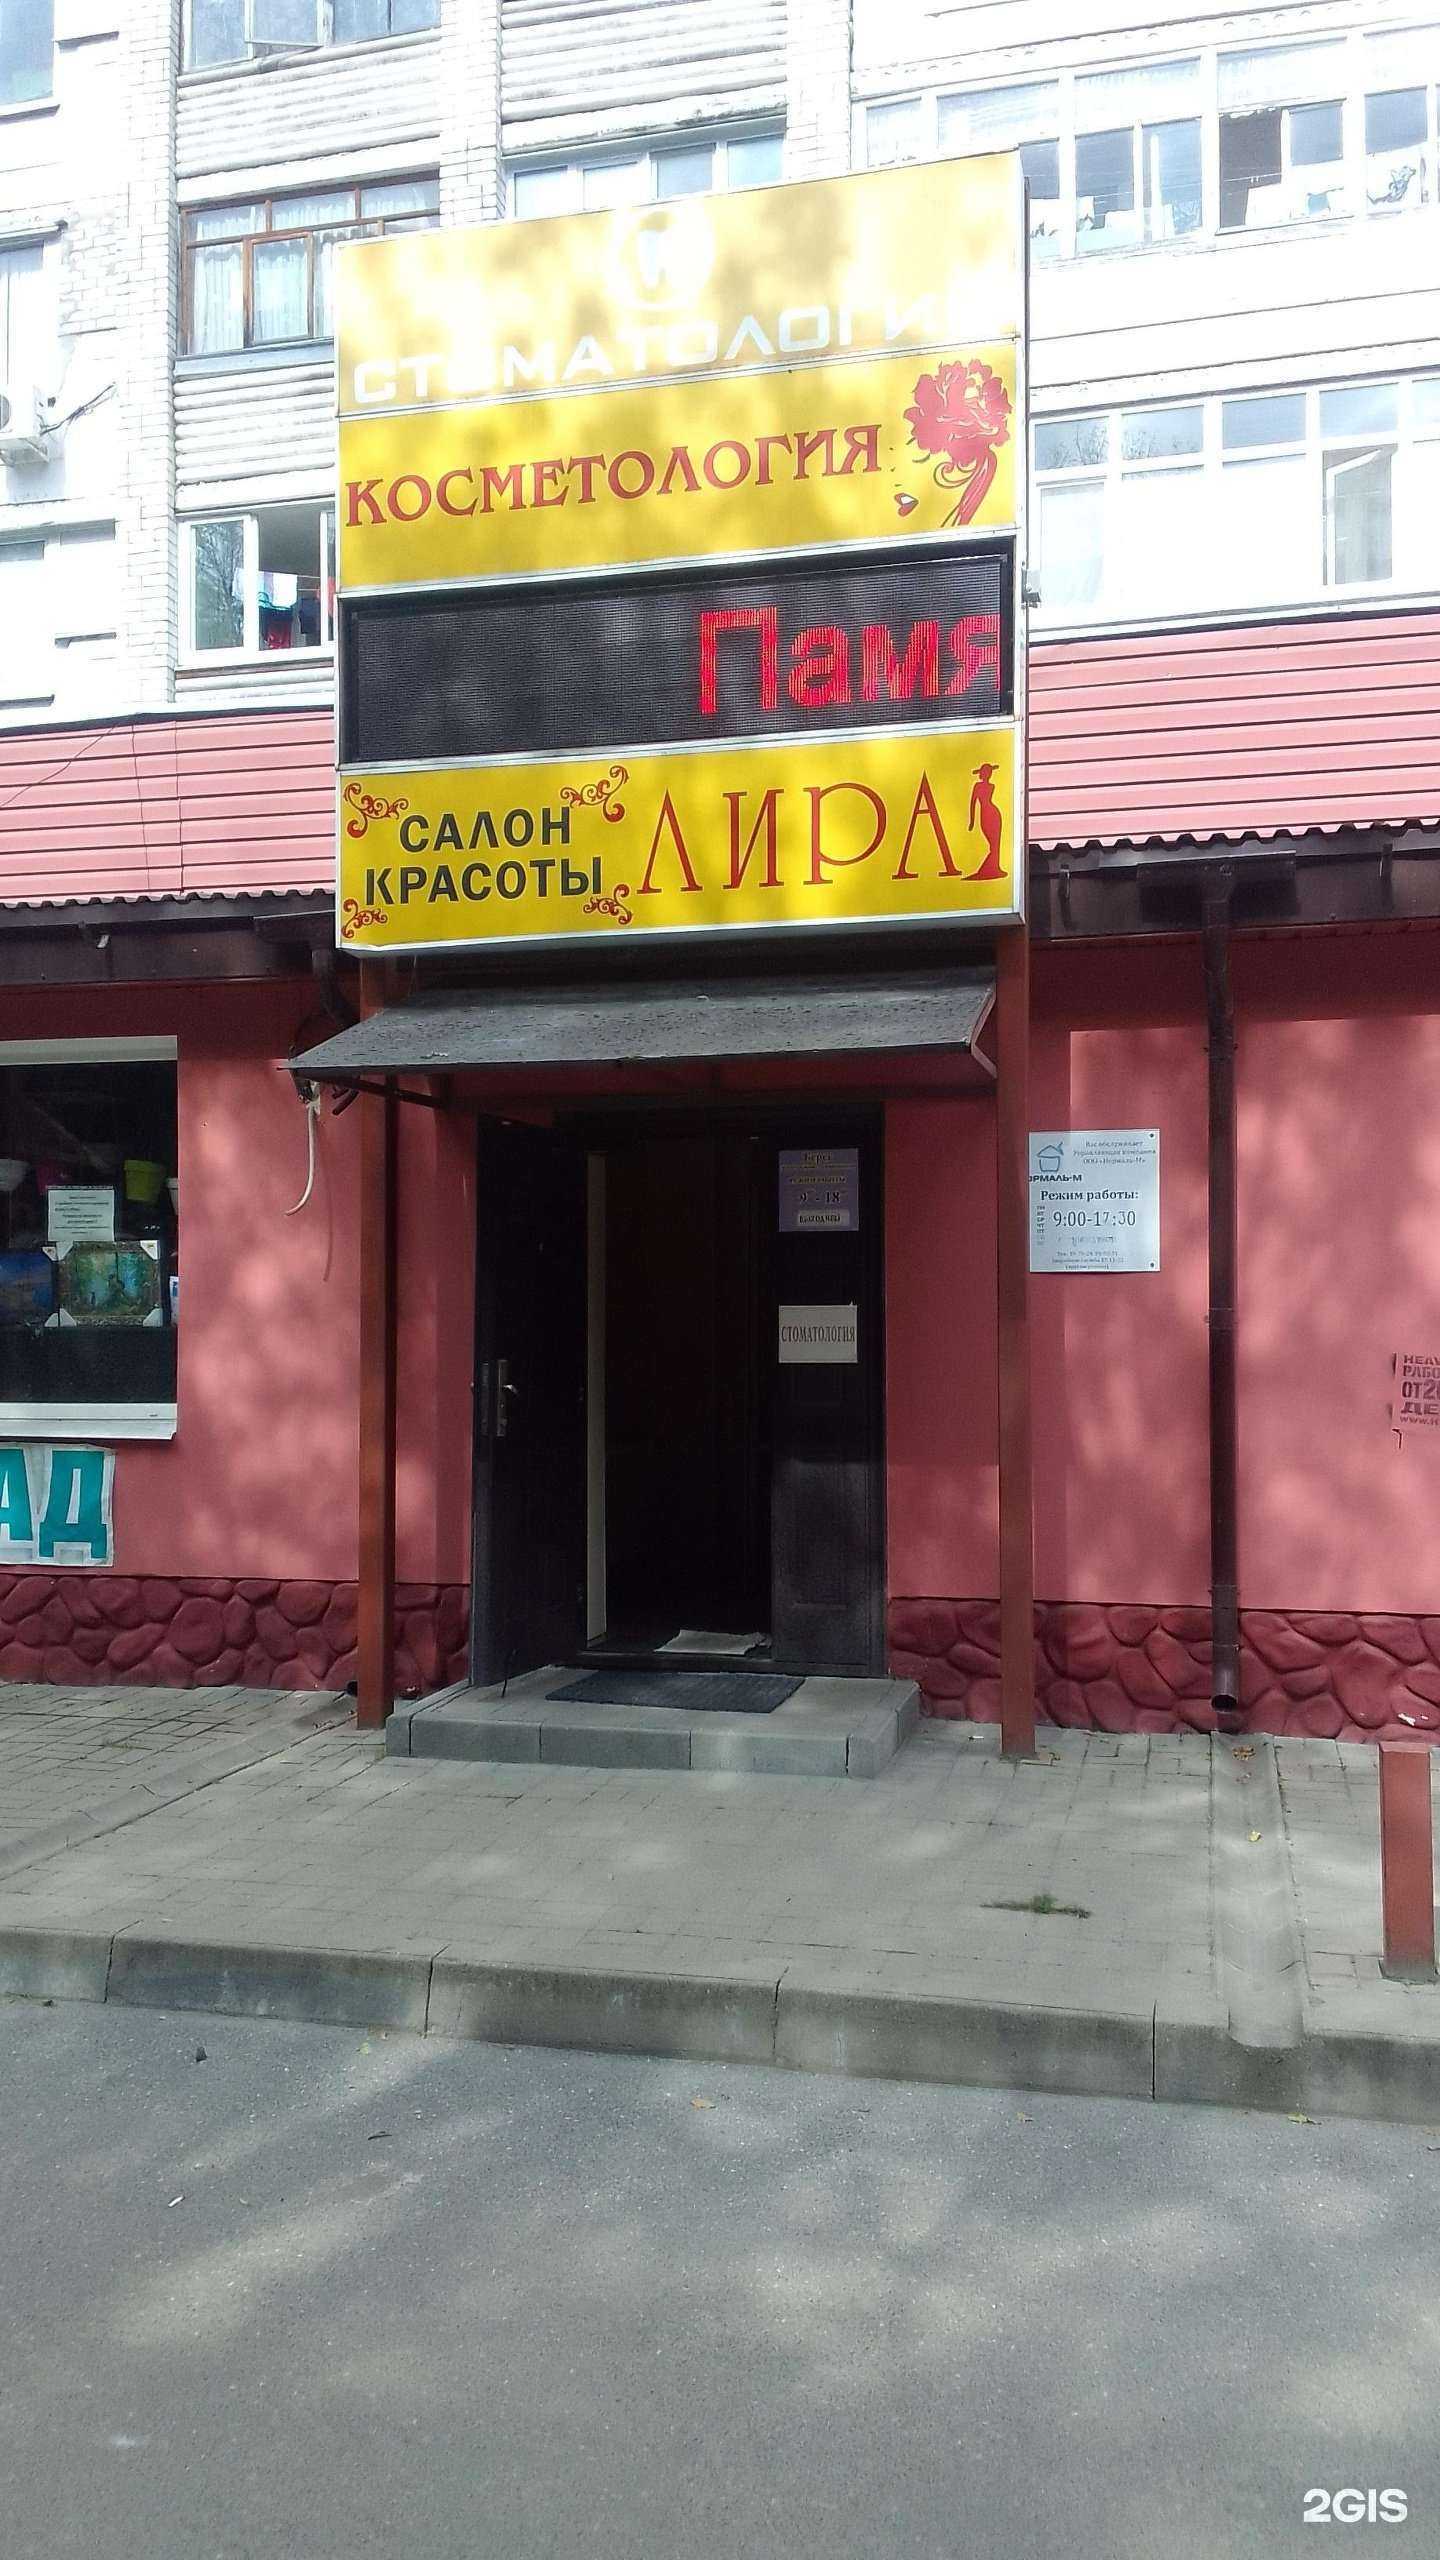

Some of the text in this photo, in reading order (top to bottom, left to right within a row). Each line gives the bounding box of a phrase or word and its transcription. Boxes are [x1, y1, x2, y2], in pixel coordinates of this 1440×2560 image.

[345, 423, 882, 527] КОСМЕТОЛОГИЯ
[699, 606, 999, 714] Памя
[400, 805, 572, 853] САЛОН
[637, 770, 963, 894] ЛИРА
[365, 856, 602, 905] КРАСОТЫ
[1041, 1189, 1139, 1202] Режим работы:
[1053, 1210, 1136, 1227] 9:00-17:30
[781, 1325, 855, 1343] СТОМАТОЛОГИЯ
